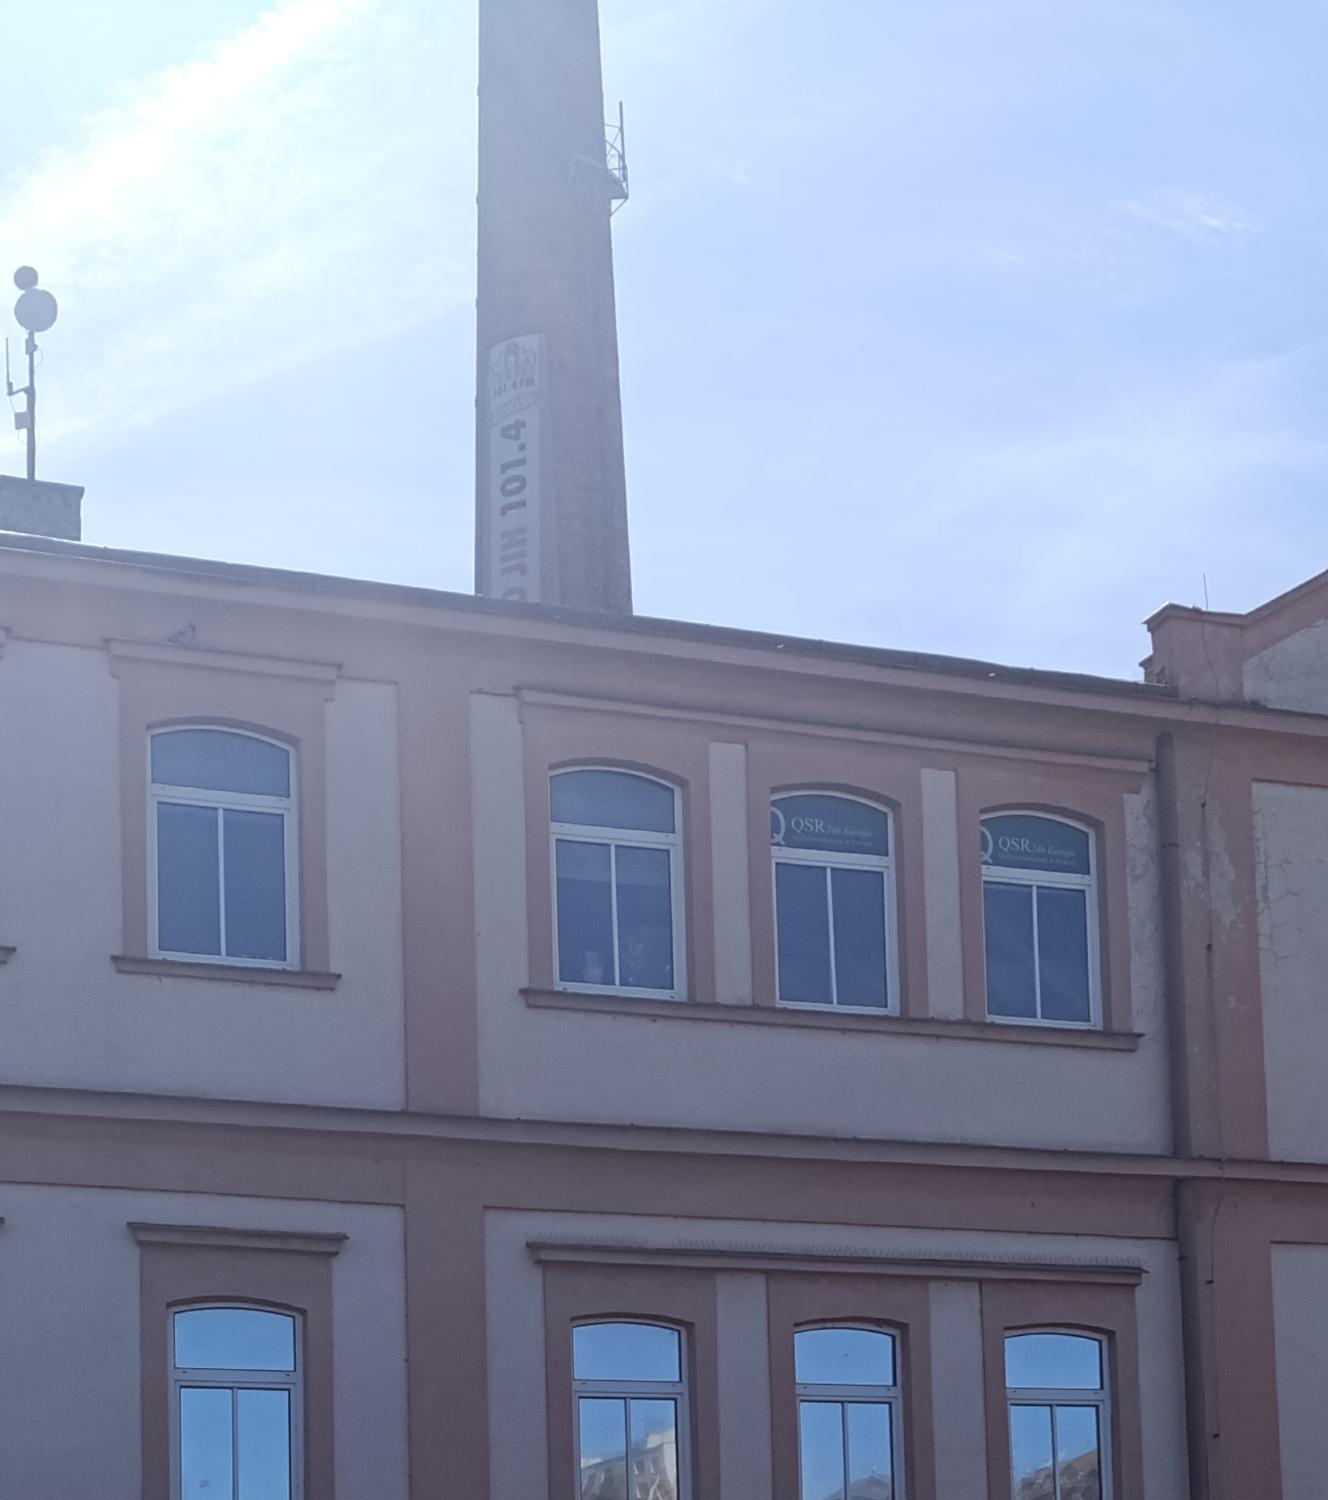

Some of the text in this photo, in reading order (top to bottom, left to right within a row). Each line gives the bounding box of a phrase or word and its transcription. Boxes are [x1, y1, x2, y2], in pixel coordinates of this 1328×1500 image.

[500, 419, 528, 517] 101.4
[791, 816, 825, 834] QSR
[998, 836, 1031, 853] QSR
